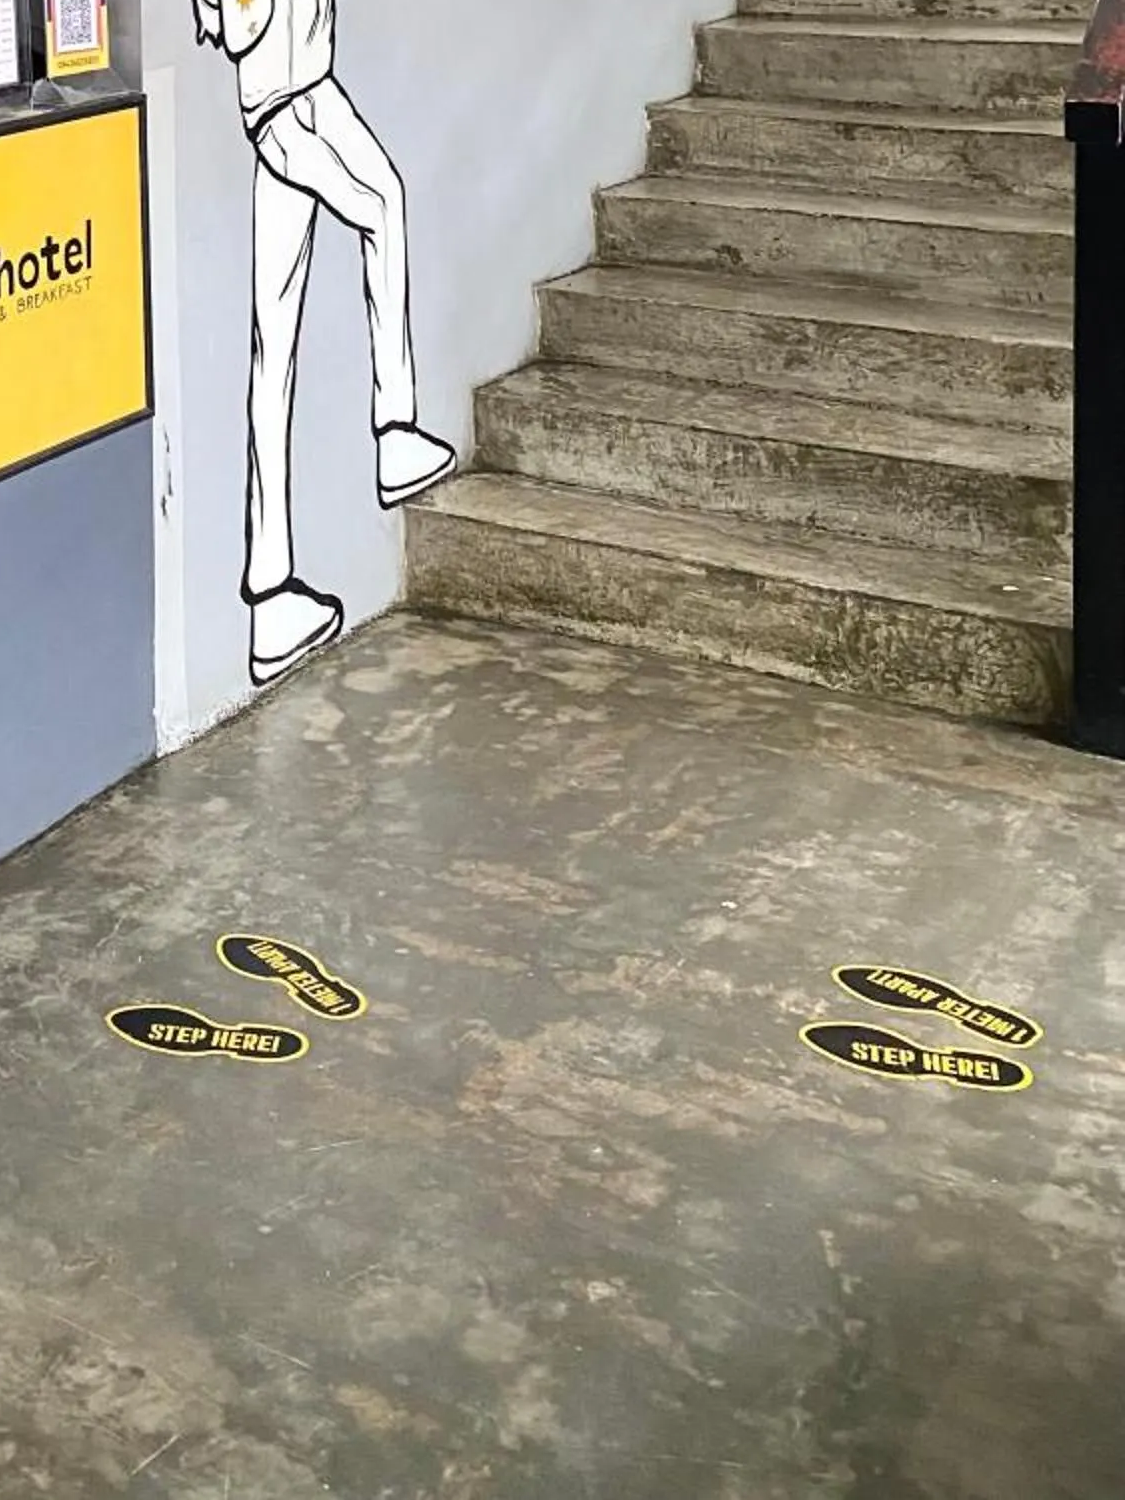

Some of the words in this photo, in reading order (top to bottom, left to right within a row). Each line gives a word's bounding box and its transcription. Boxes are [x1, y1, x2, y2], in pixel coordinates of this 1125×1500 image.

[16, 275, 93, 314] BREAKFAST
[286, 970, 346, 1008] METER
[936, 997, 1014, 1037] METER
[1011, 1028, 1028, 1042] 1
[148, 1023, 206, 1044] STEP
[211, 1029, 280, 1053] HERE!
[851, 1041, 915, 1068] STEP
[923, 1051, 1001, 1081] HERE!
